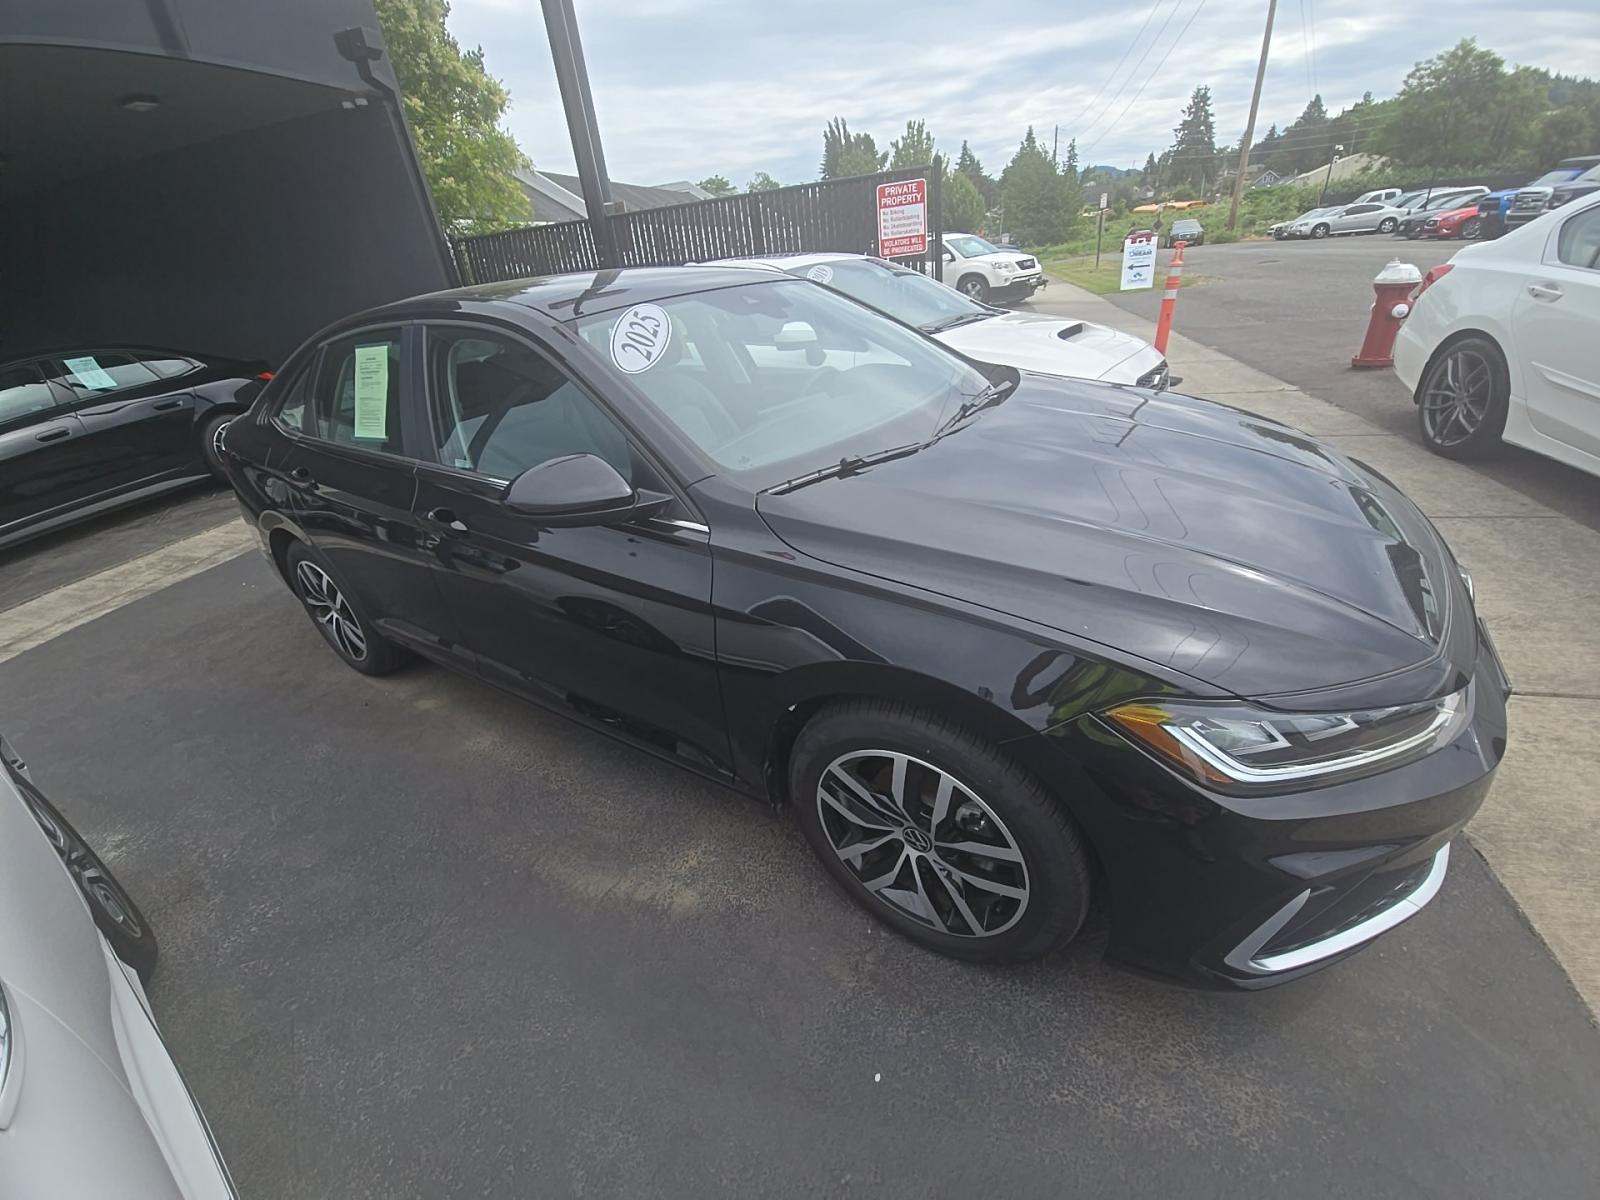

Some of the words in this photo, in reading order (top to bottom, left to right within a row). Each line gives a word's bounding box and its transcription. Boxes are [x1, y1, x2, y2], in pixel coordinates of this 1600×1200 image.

[885, 183, 918, 196] PRIVATE
[881, 193, 922, 206] PROPERTY
[884, 238, 910, 247] VIOLATORS
[883, 247, 890, 255] BE
[891, 244, 923, 253] PROSECUTED
[621, 310, 661, 362] 2025
